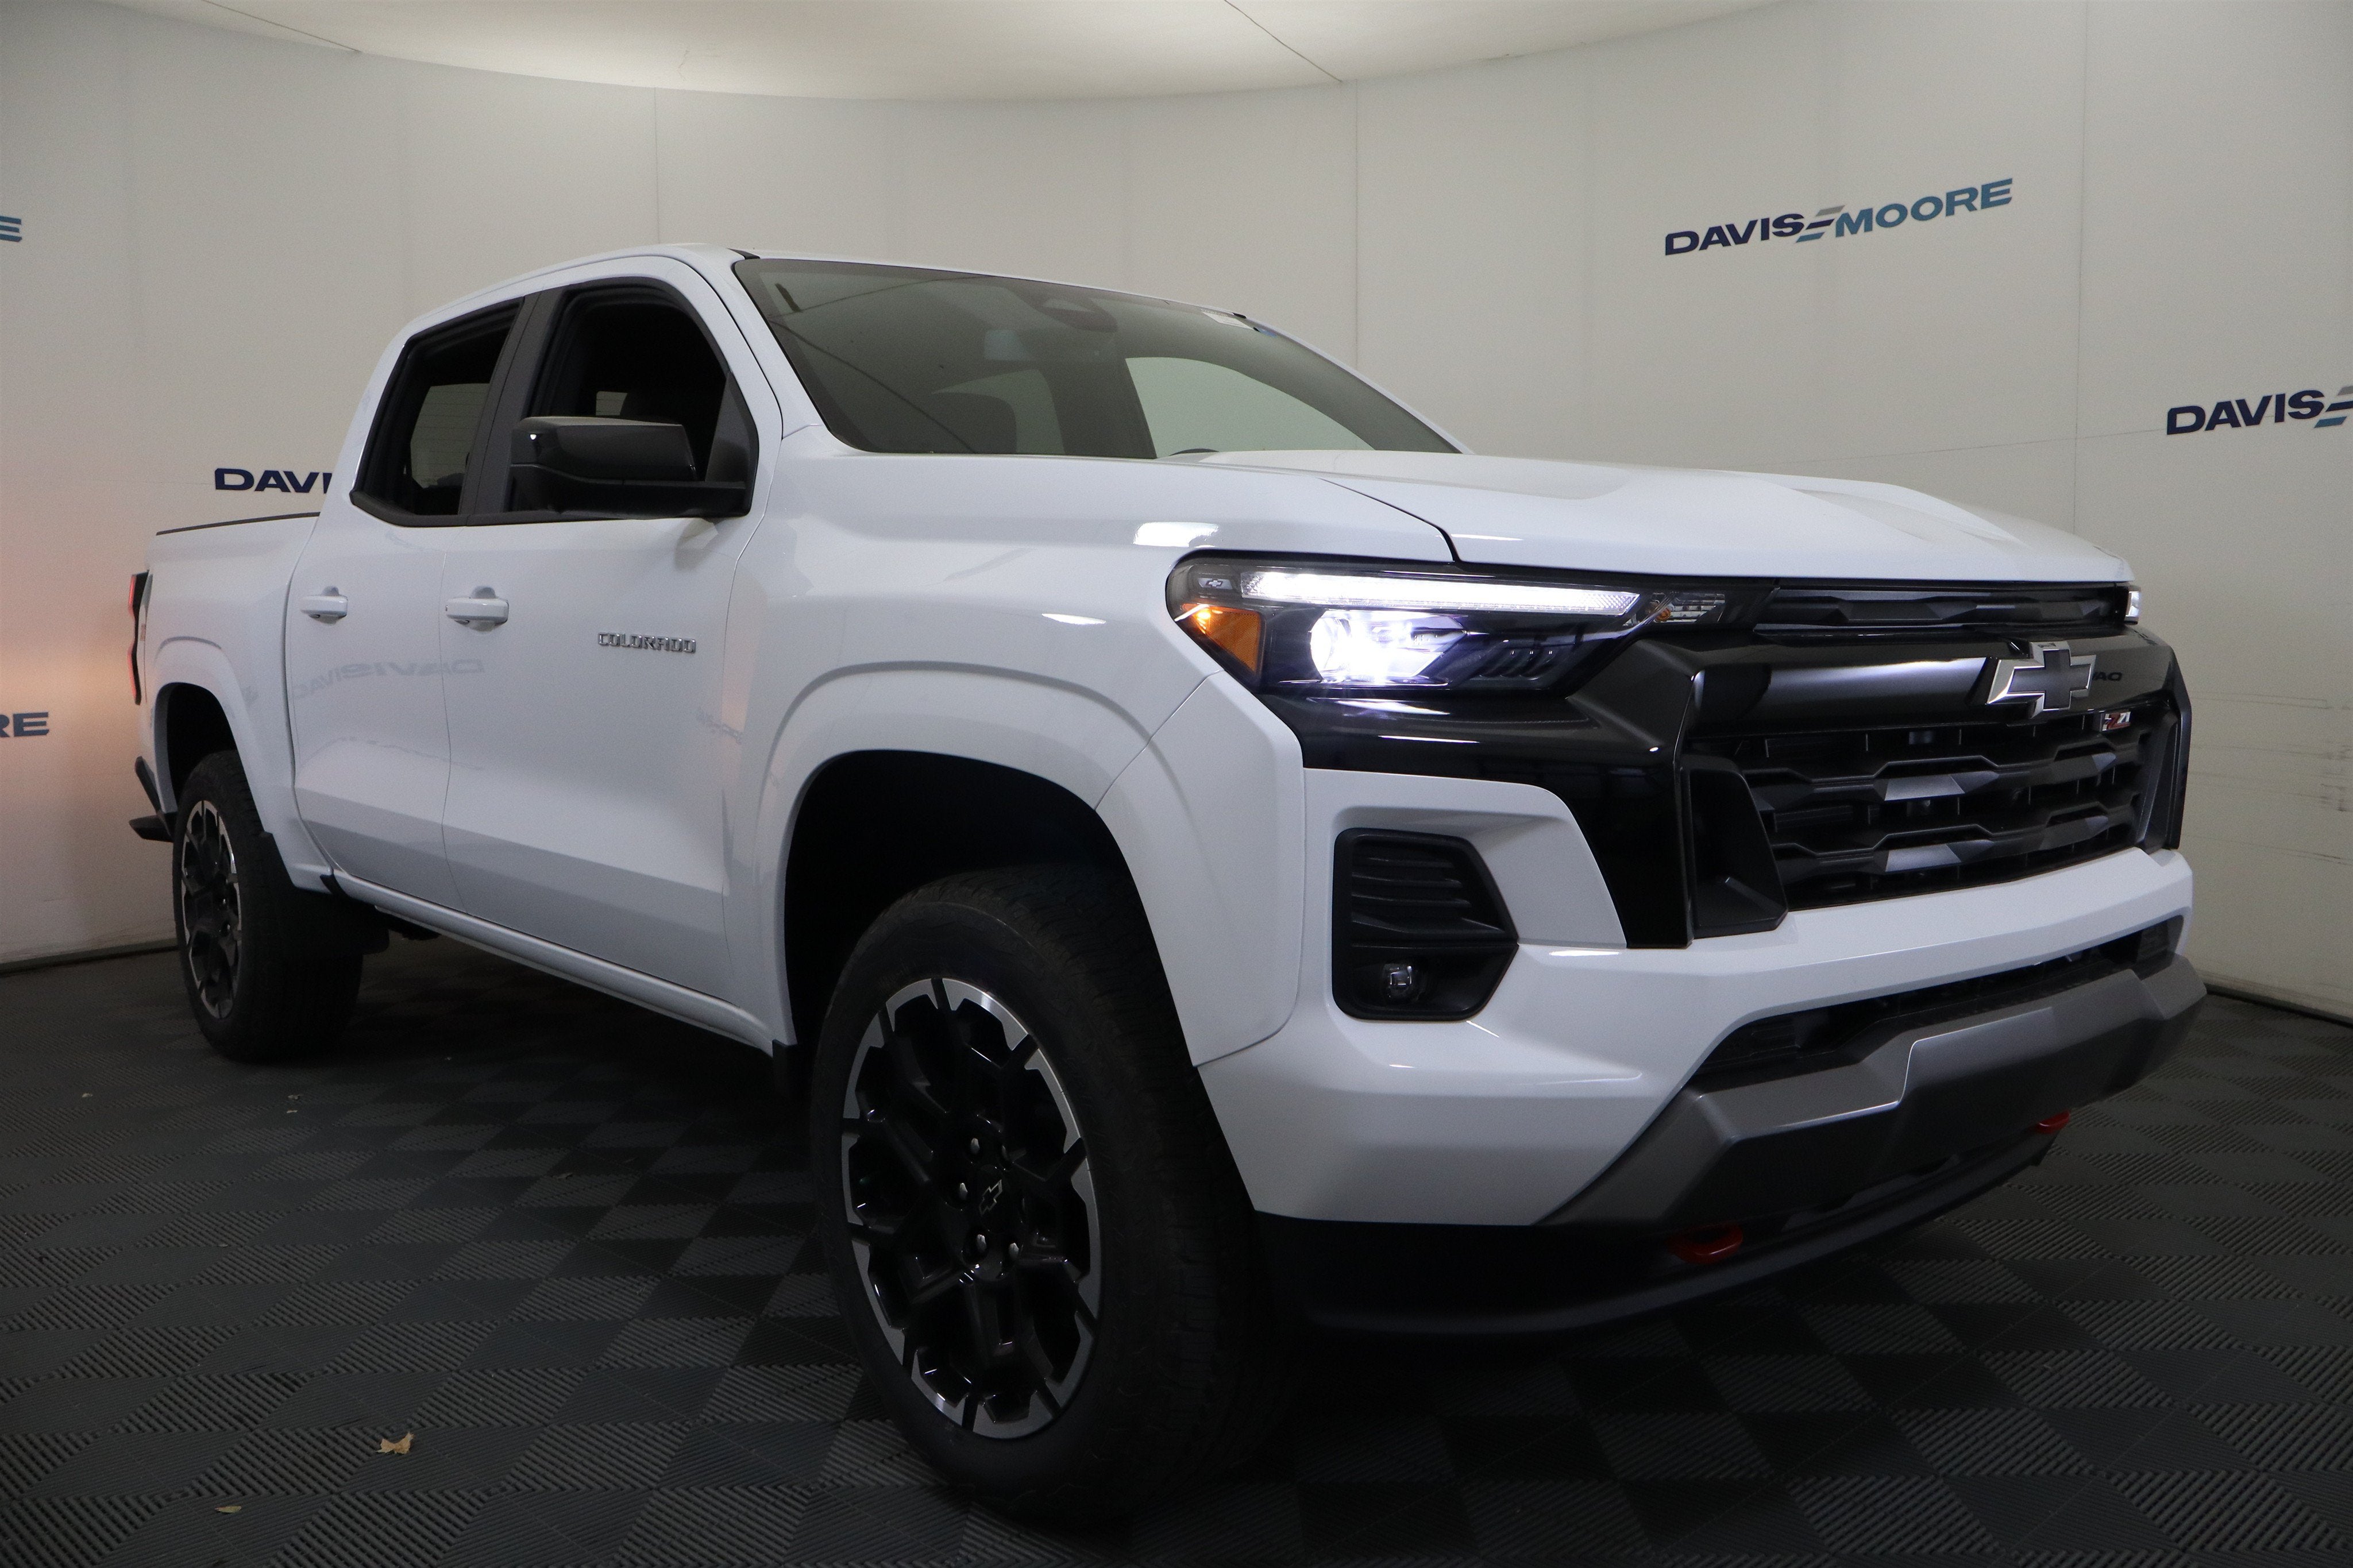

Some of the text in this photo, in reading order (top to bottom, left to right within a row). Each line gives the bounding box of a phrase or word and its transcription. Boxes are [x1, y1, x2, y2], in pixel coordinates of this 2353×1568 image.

[1665, 178, 2013, 256] DAVIS MOORE
[2167, 389, 2325, 435] DAVIS
[598, 632, 697, 654] COLORADO
